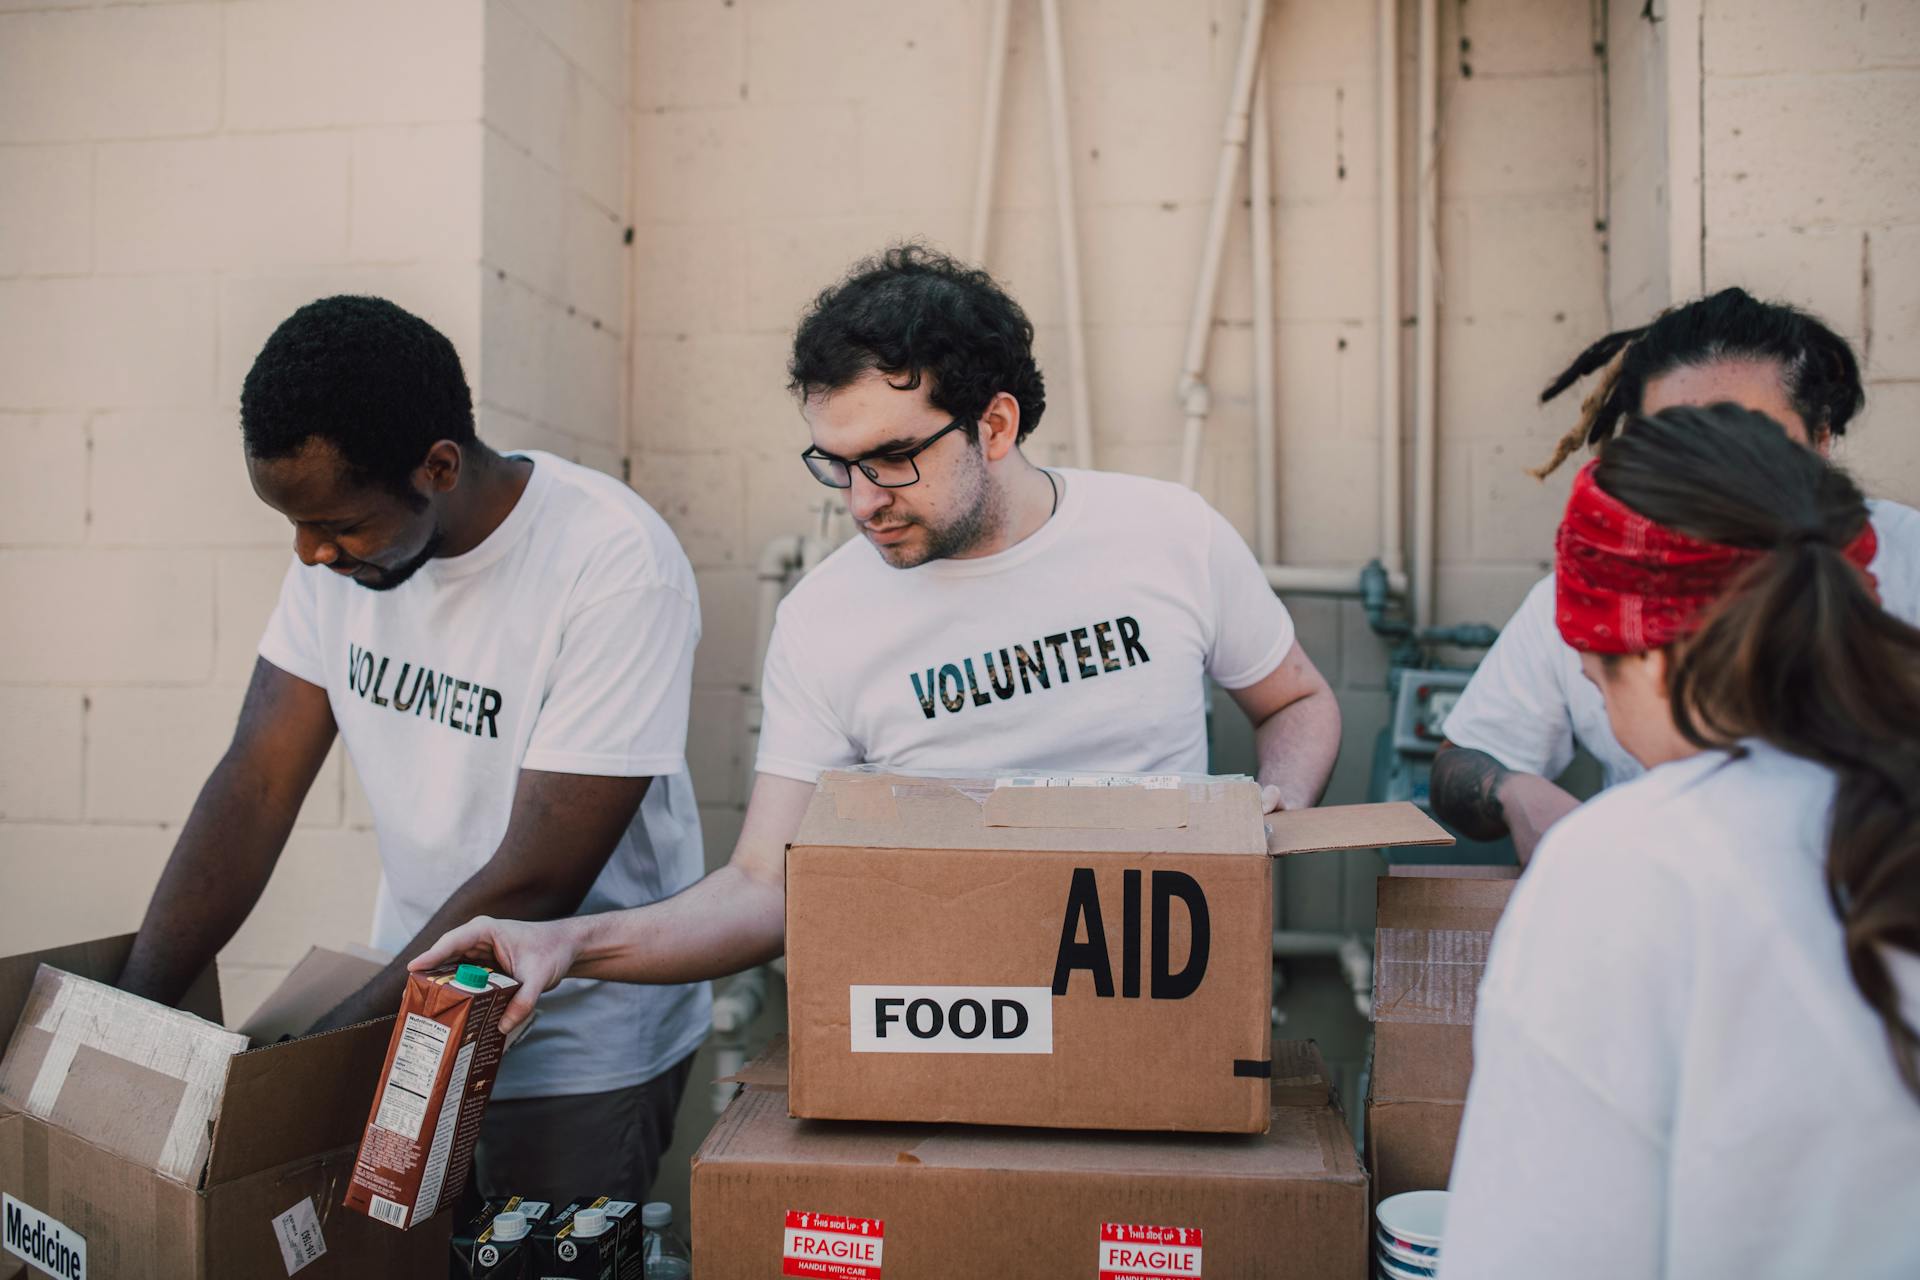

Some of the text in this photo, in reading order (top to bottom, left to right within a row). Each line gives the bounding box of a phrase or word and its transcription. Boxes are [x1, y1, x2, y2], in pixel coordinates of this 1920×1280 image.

[910, 616, 1151, 719] VOLUNTEER
[1052, 868, 1211, 999] AID
[875, 998, 1029, 1039] FOOD
[814, 1219, 857, 1230] THIS SIDE UP
[1129, 1231, 1174, 1241] THIS SIDE UP
[7, 1202, 81, 1280] Medicine
[793, 1236, 875, 1261] FRAGILE
[798, 1261, 867, 1276] HANDLE WITH CARE
[1109, 1249, 1193, 1271] FRAGILE
